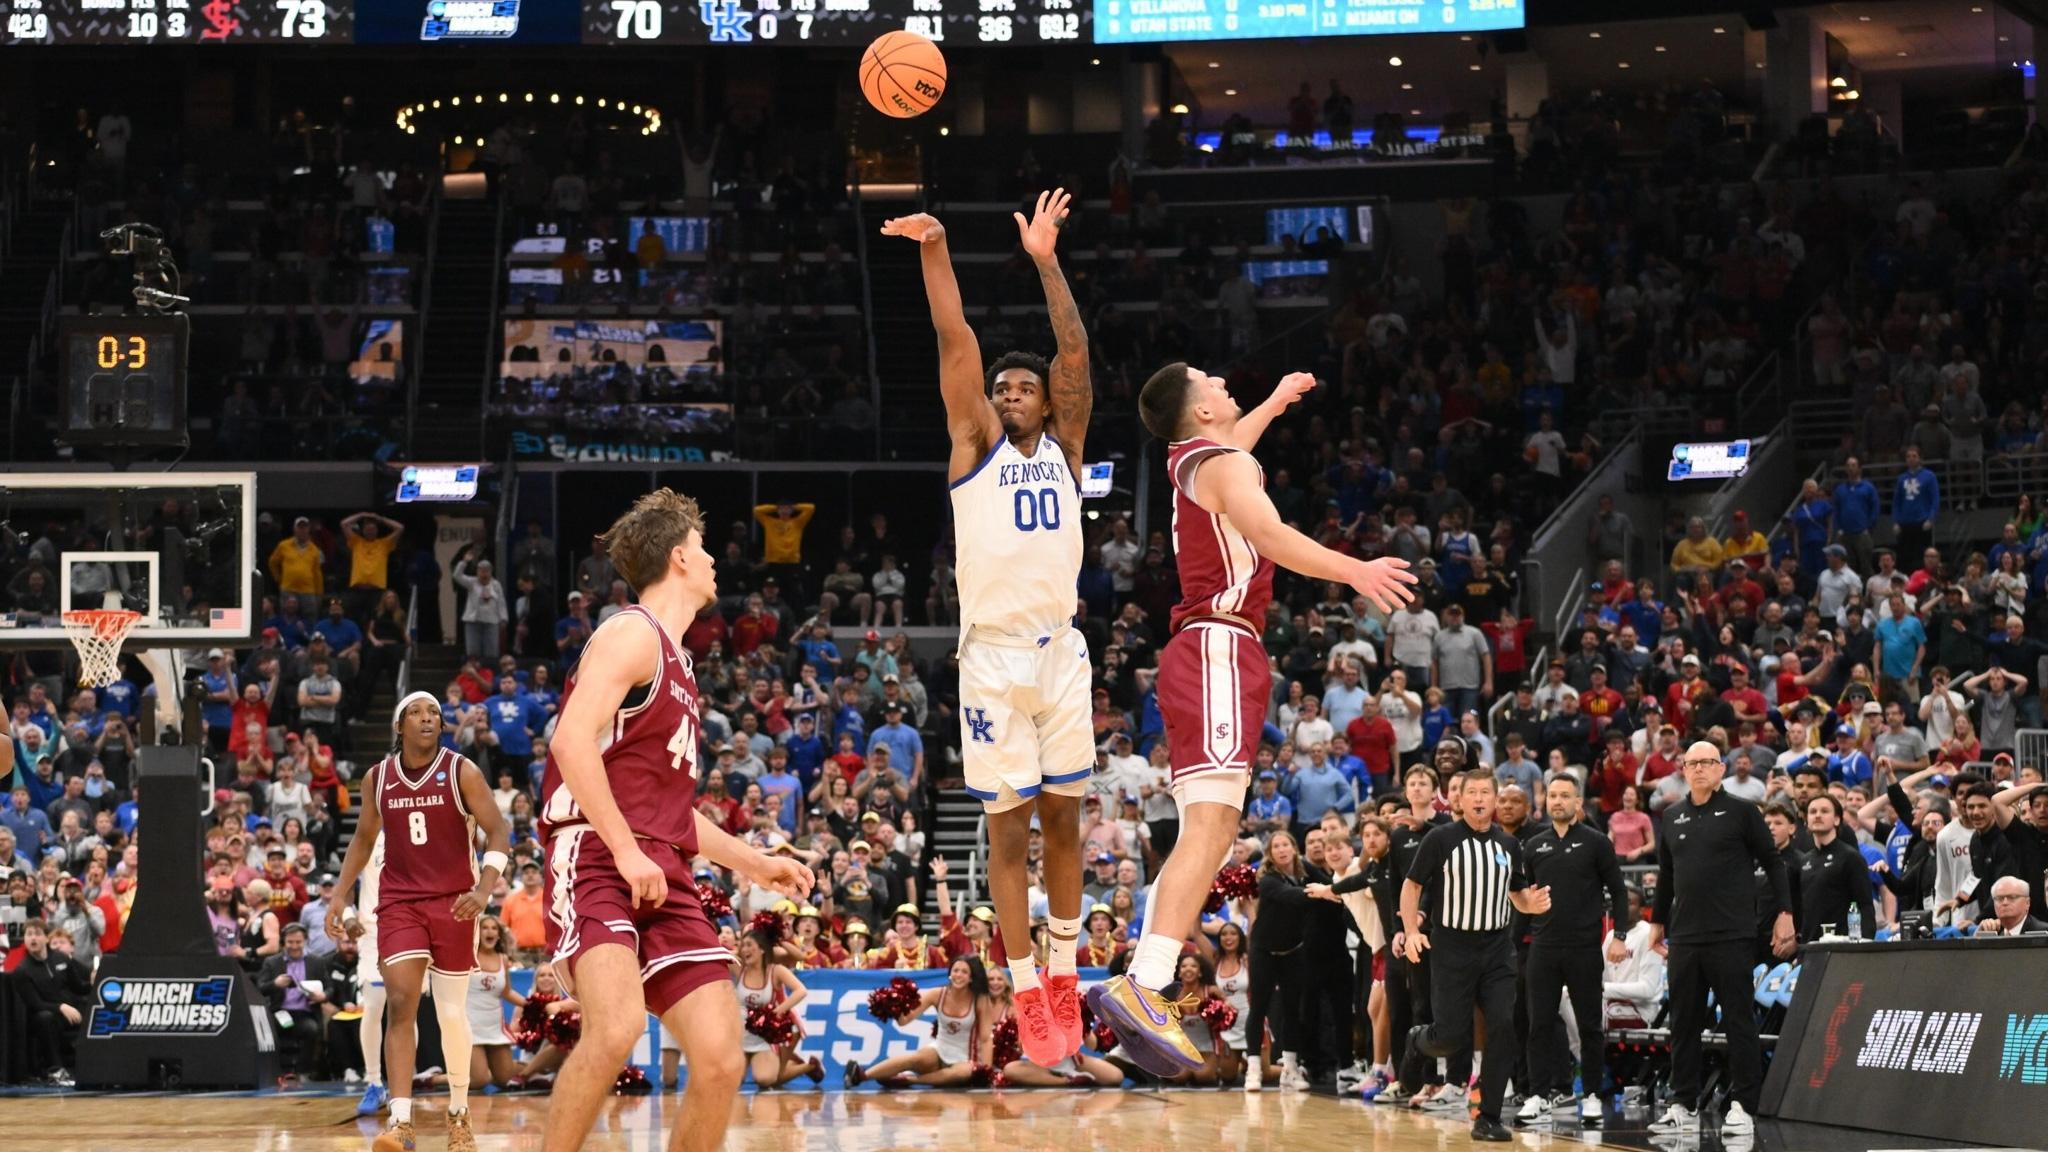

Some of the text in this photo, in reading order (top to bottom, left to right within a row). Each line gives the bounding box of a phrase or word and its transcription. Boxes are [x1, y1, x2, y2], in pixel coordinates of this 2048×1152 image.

[8, 13, 48, 38] 42.9
[128, 13, 157, 37] 10
[168, 13, 186, 37] 3
[276, 0, 326, 37] 73
[611, 1, 662, 39] 70
[700, 0, 752, 41] UK
[759, 14, 777, 39] 0
[796, 14, 813, 39] 7
[978, 16, 1012, 41] 36
[1169, 16, 1213, 32] STATE
[1014, 488, 1060, 532] 00
[963, 706, 994, 744] UK
[666, 714, 697, 780] 44
[388, 794, 445, 809] SANTA CLARA
[408, 811, 428, 846] 8
[122, 983, 194, 1004] MARCH
[130, 1004, 227, 1026] MADNESS
[1856, 1009, 1984, 1075] SANTA CLARA
